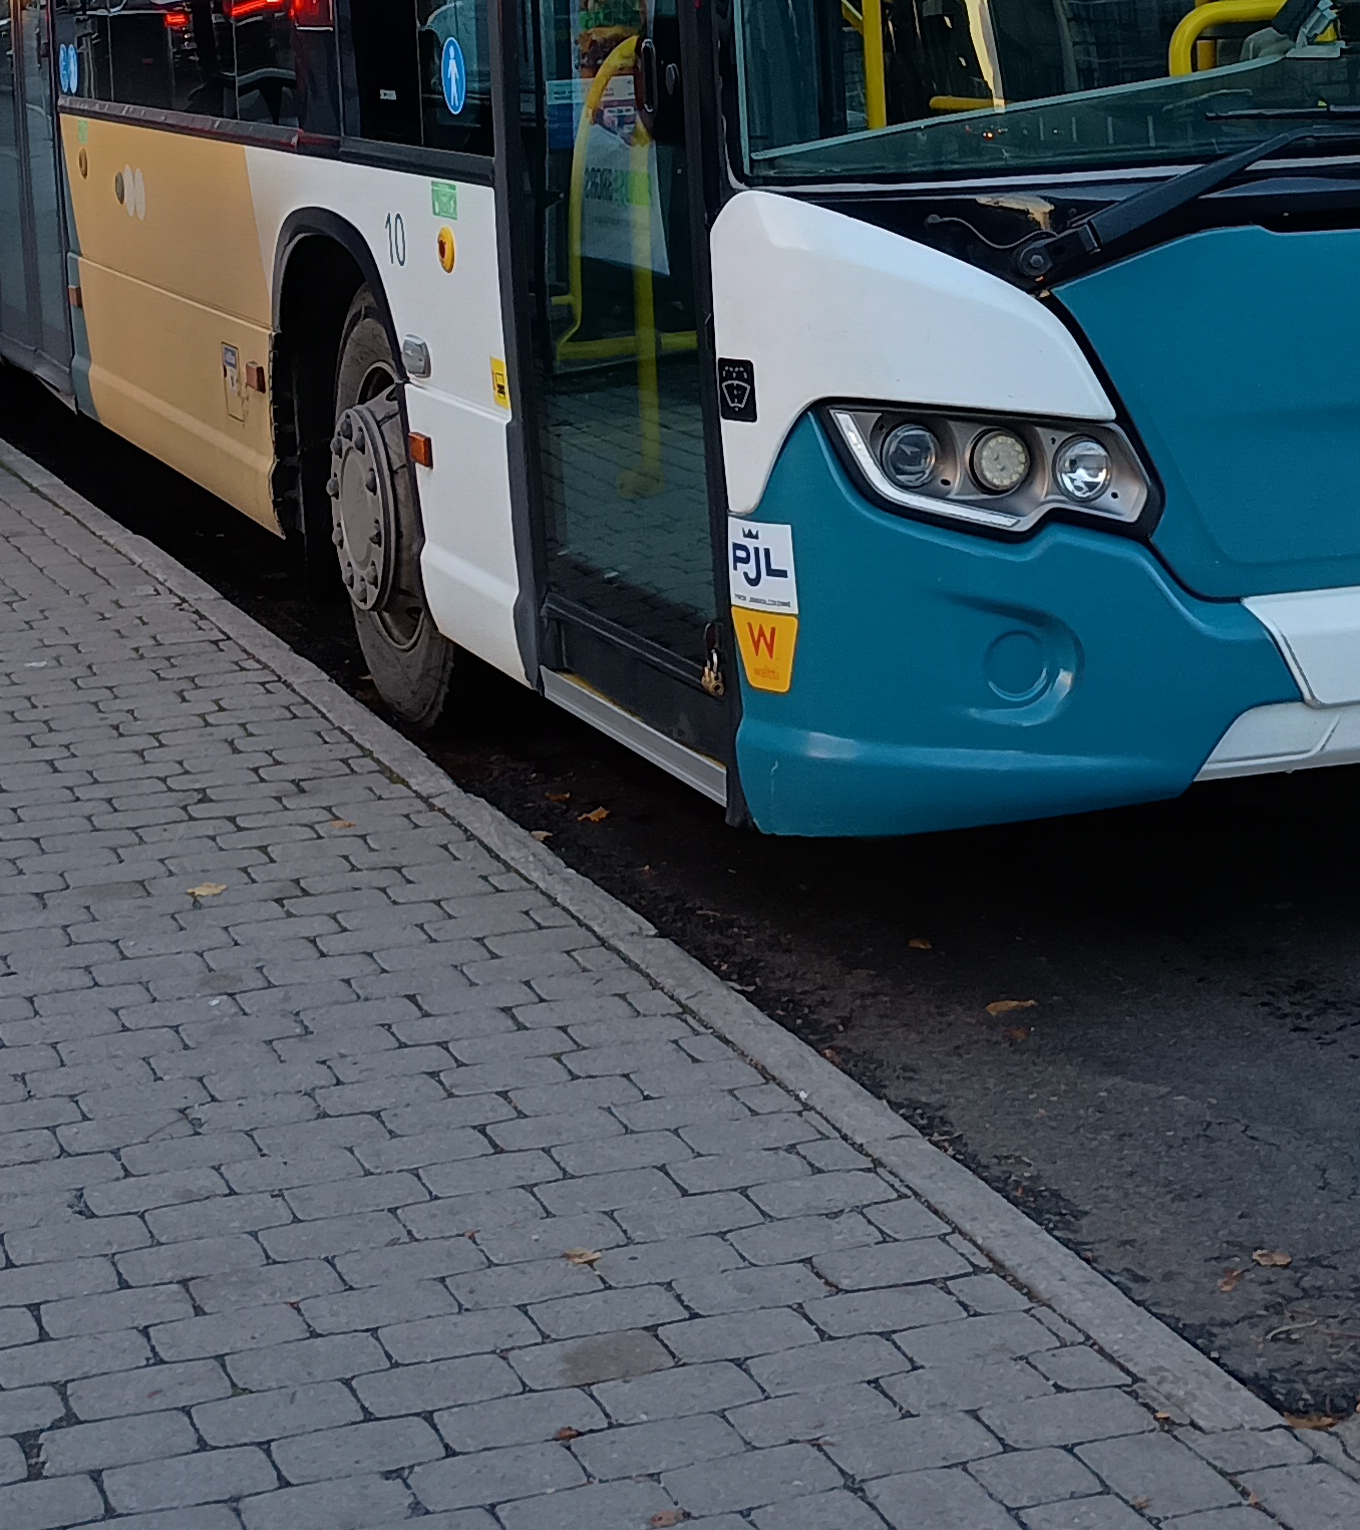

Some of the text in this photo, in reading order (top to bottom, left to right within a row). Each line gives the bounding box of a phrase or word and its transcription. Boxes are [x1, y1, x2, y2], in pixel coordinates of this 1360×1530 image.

[384, 211, 407, 267] 10
[731, 541, 789, 587] PJL
[746, 621, 777, 660] W
